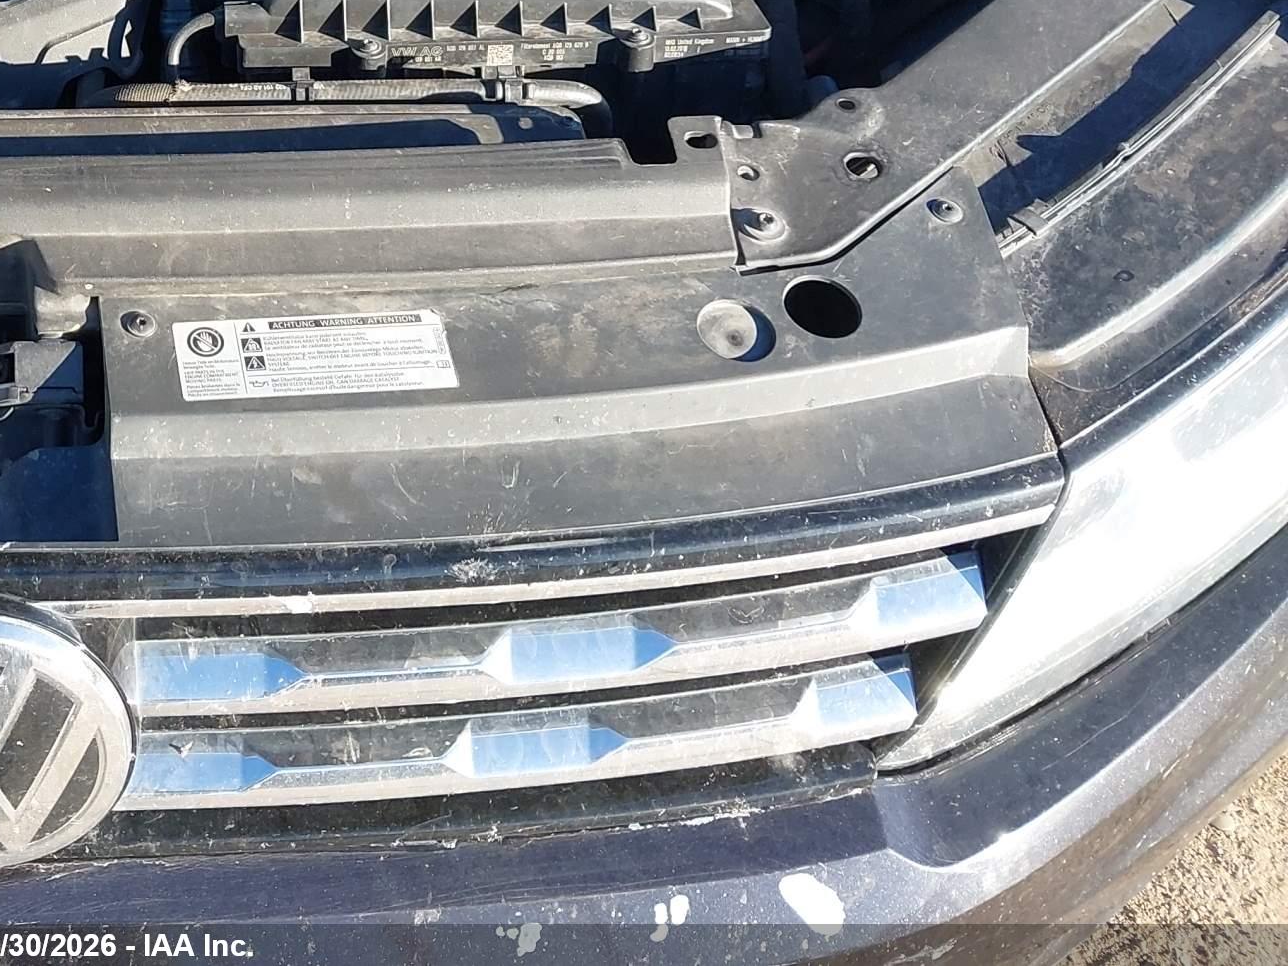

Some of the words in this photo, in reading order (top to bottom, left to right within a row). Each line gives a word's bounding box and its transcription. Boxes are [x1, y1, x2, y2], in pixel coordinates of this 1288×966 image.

[391, 47, 417, 57] VW
[420, 45, 444, 57] AG
[272, 320, 316, 329] ACHTUNG
[319, 317, 364, 326] WARNING
[367, 314, 416, 324] ATTENTION
